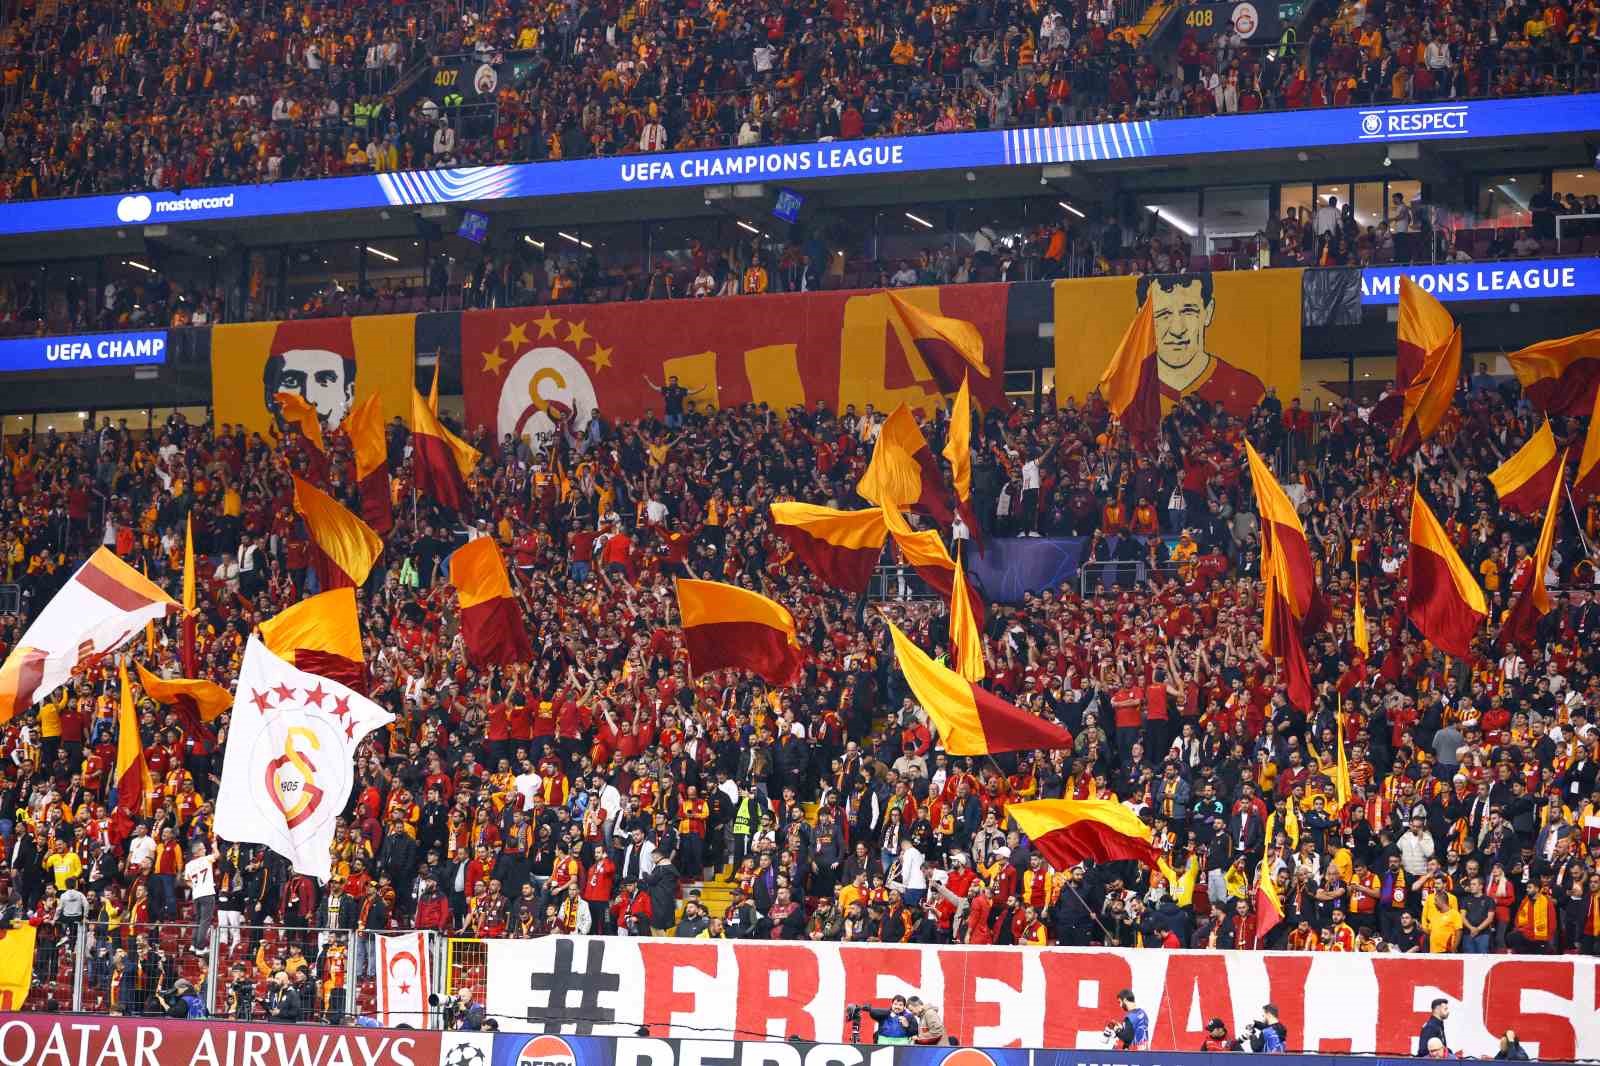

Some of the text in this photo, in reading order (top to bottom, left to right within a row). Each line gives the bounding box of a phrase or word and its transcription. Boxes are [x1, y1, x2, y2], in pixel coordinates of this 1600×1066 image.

[1185, 9, 1213, 27] 408
[434, 69, 458, 87] 407
[1388, 112, 1468, 131] RESPECT
[621, 145, 904, 181] UEFA CHAMPIONS LEAGUE
[156, 193, 234, 212] mastercard
[1477, 268, 1576, 291] LEAGUE
[47, 339, 164, 361] UEFA CHAMP
[0, 1020, 416, 1066] QATAR AIRWAYS
